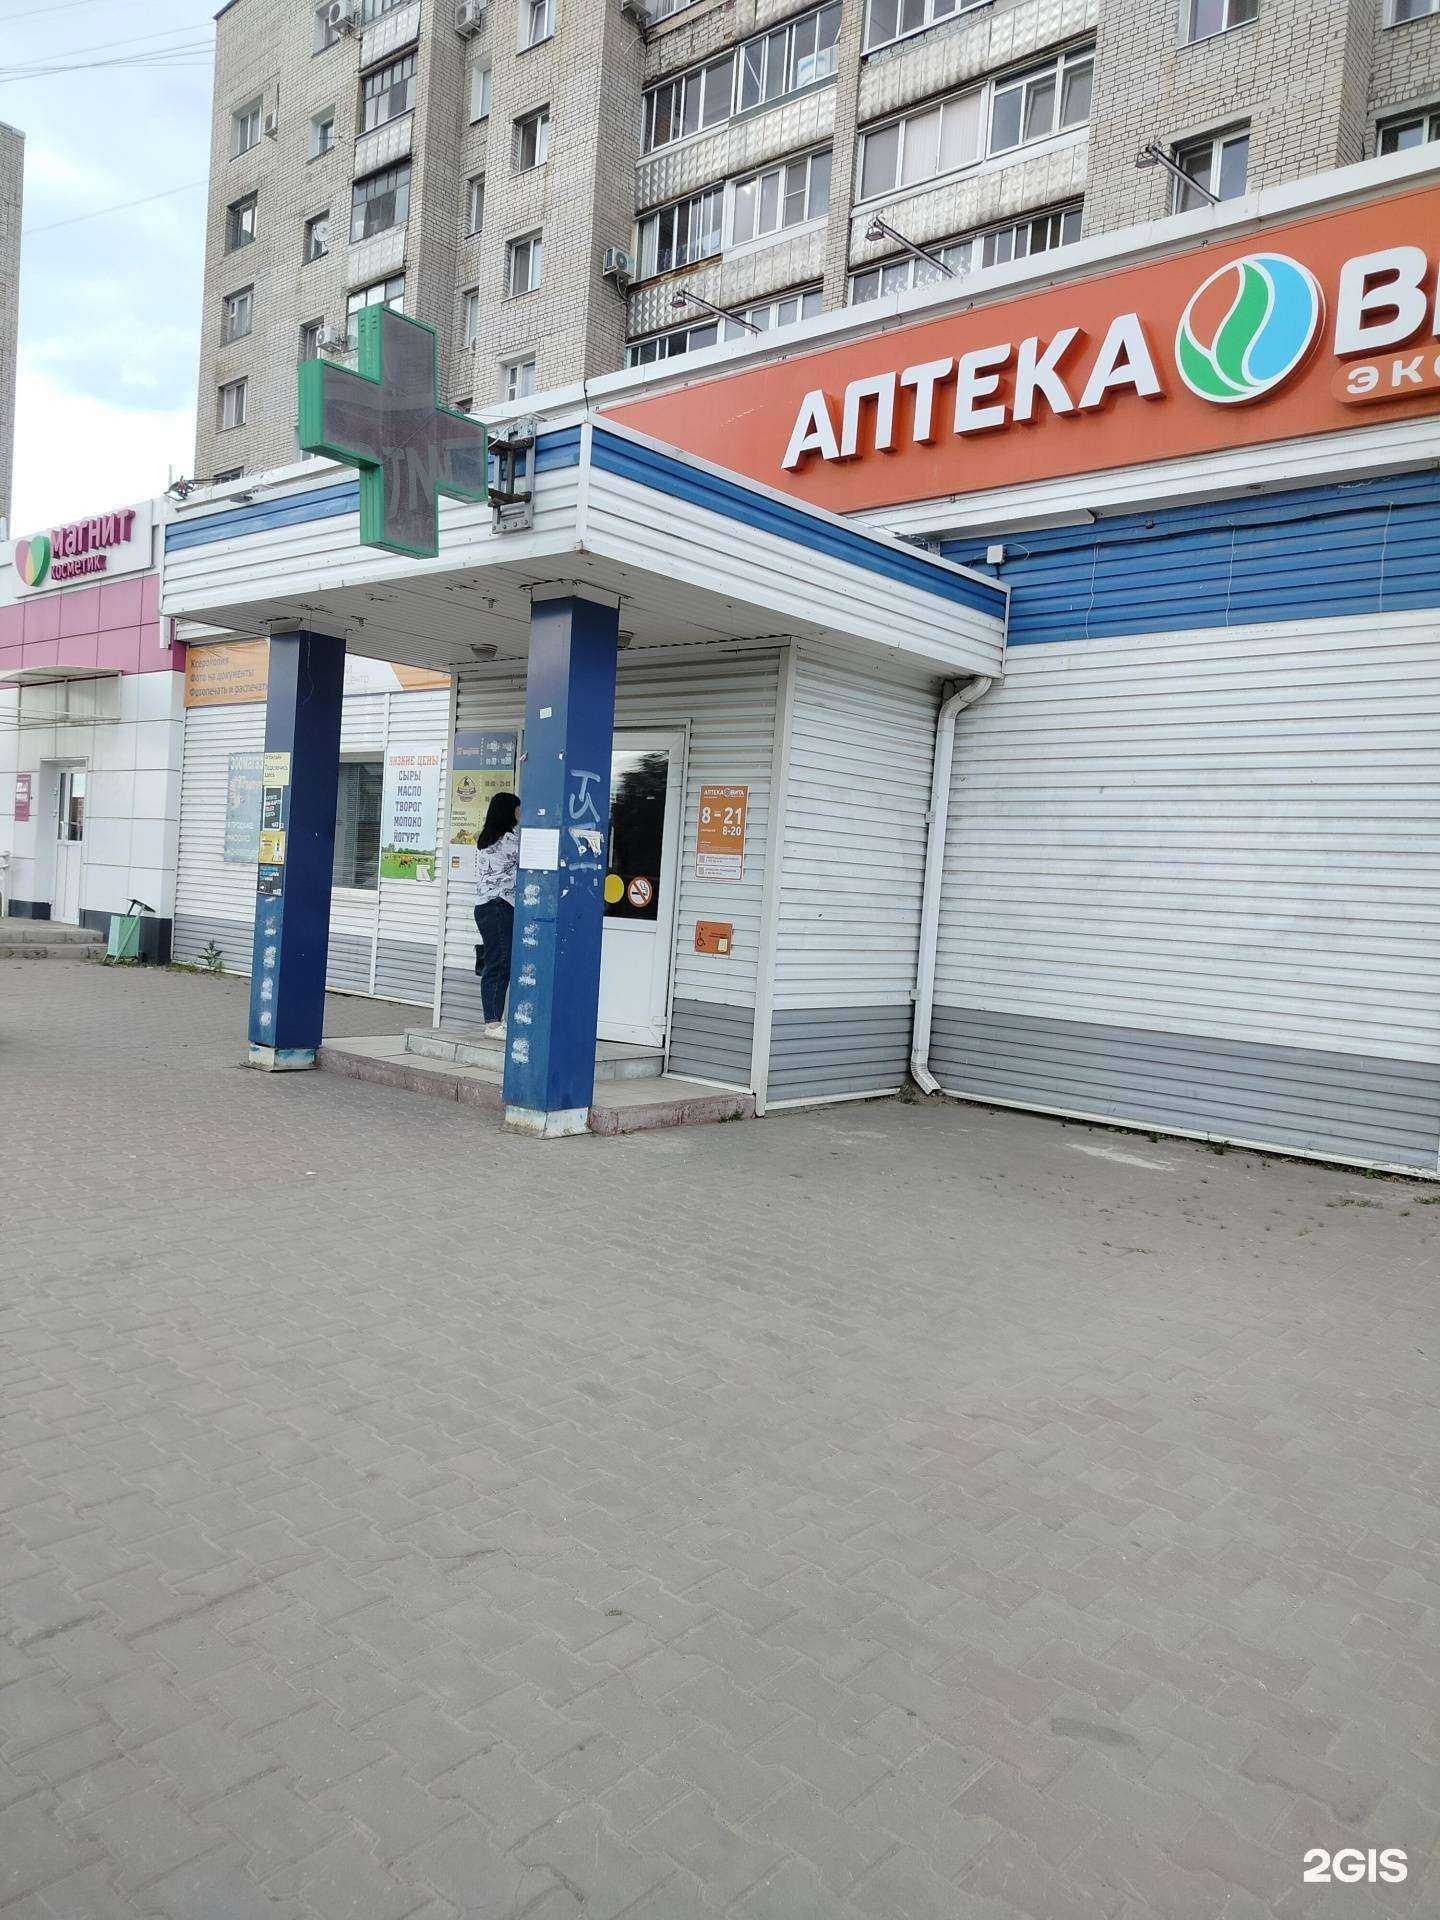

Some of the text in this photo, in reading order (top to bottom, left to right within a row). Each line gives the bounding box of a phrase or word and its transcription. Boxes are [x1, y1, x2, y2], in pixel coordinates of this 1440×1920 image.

[780, 245, 1440, 470] АПТЕКА В
[1346, 353, 1440, 394] ЭК
[398, 770, 421, 781] СЫРЫ
[397, 785, 422, 797] МАСЛО
[395, 801, 422, 812] ТВОРОГ
[393, 816, 422, 827] МОЛОКО
[393, 830, 421, 843] ЙОГУРТ
